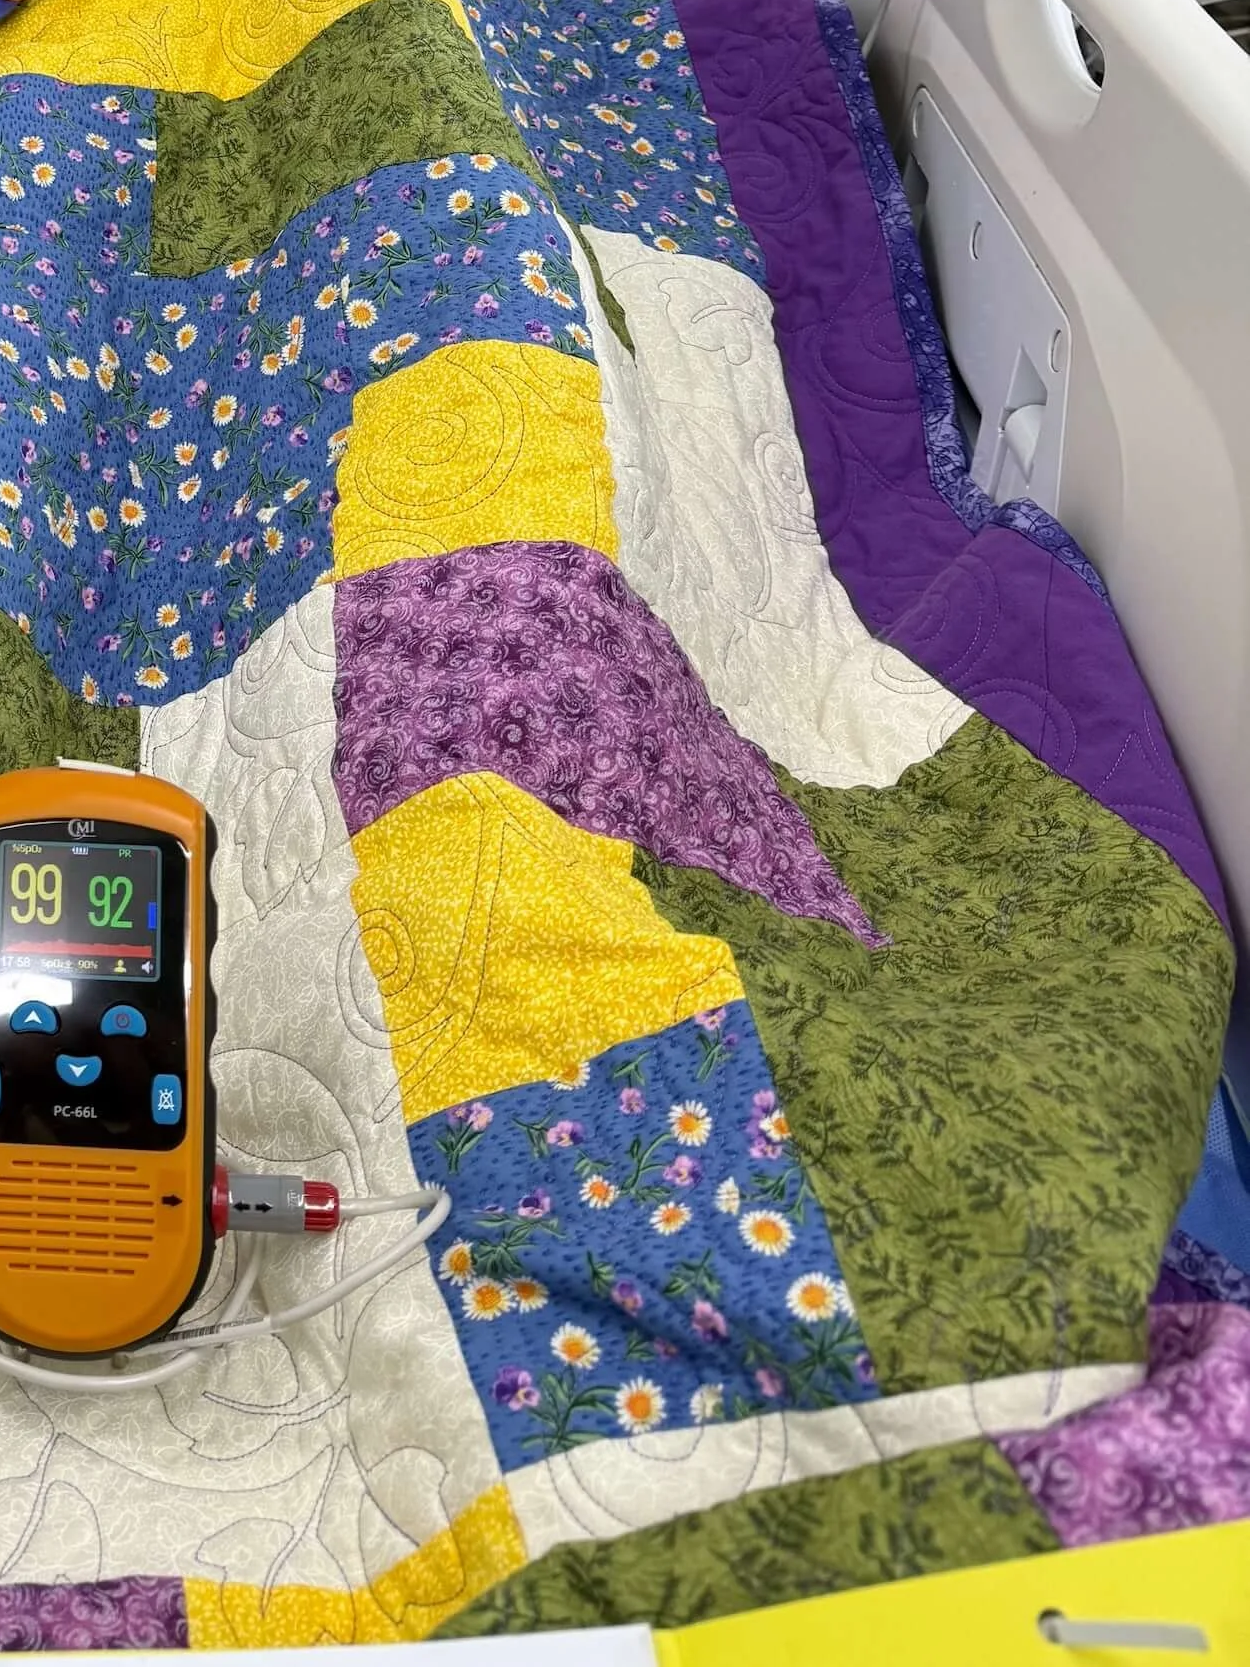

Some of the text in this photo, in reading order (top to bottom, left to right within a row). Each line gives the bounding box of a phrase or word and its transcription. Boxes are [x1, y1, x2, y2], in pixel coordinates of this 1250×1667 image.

[118, 848, 133, 858] PR
[10, 862, 63, 926] 99
[88, 875, 134, 929] 92
[53, 1104, 98, 1119] PC-66L
